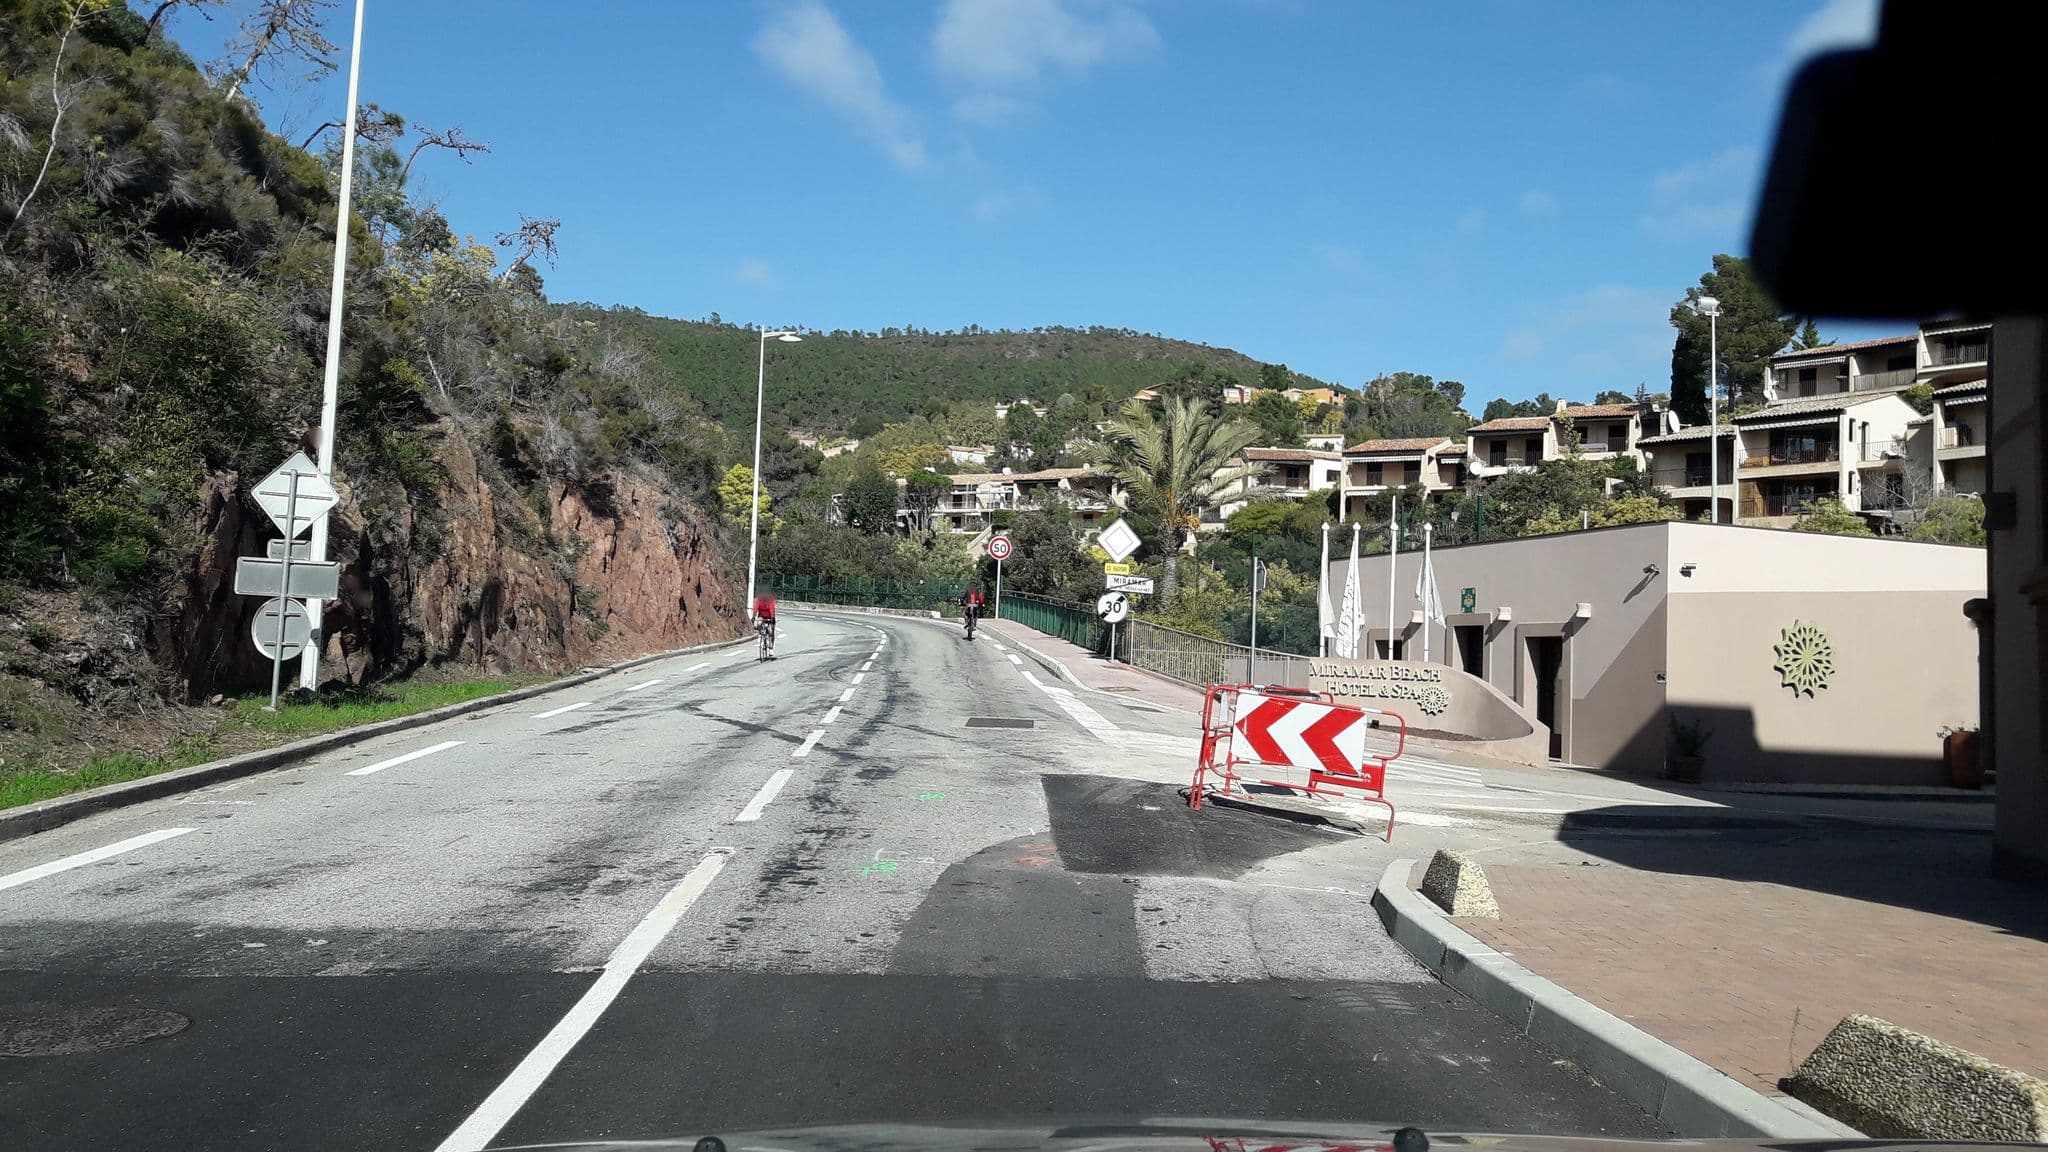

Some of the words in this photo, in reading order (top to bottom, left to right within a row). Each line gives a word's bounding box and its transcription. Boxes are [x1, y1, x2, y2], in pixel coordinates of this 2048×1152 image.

[994, 543, 1006, 553] 50
[1105, 601, 1121, 613] 30
[1309, 662, 1387, 680] MIRAMAR
[1390, 664, 1442, 682] BEACH
[1326, 681, 1377, 698] HOTEL
[1378, 685, 1390, 699] &
[1391, 683, 1421, 701] SPA
